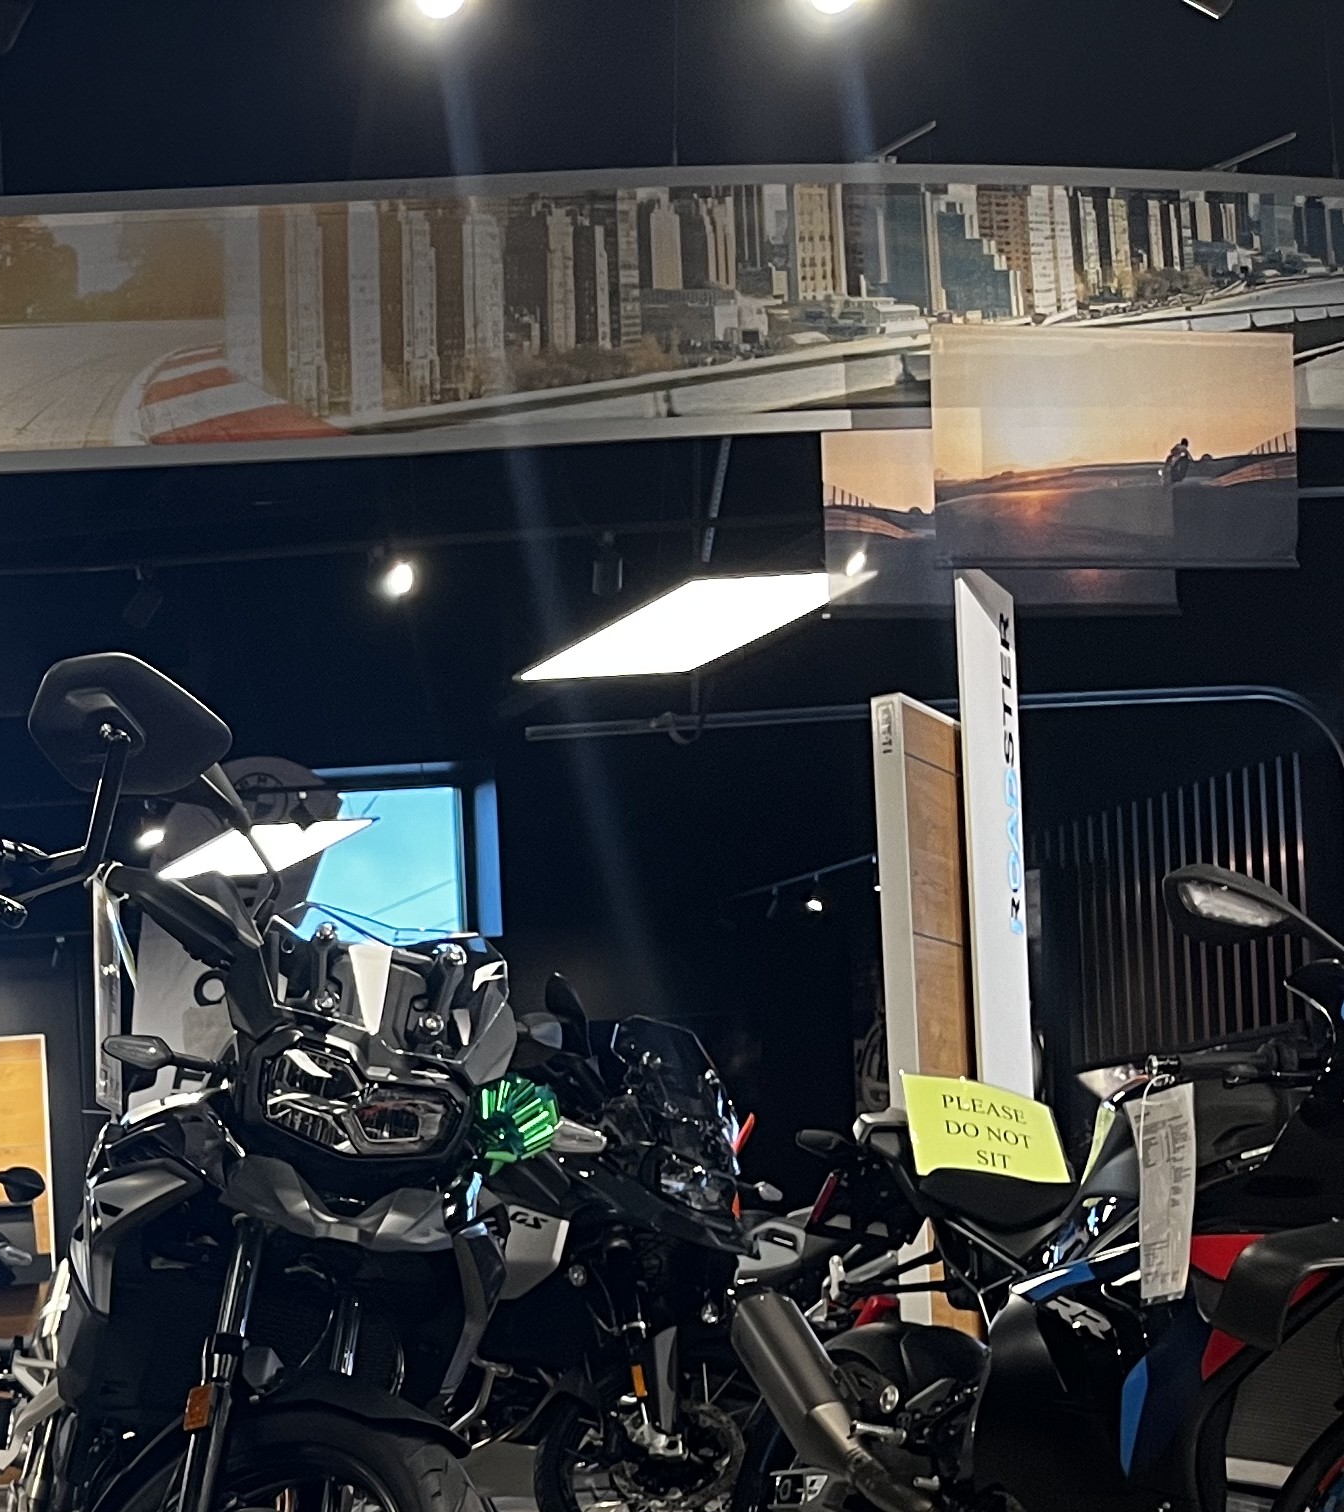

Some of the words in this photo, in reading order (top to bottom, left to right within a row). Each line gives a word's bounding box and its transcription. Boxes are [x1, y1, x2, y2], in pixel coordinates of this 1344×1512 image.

[998, 612, 1023, 934] ROADSTER
[941, 1094, 1027, 1125] PLEASE
[945, 1120, 979, 1138] DO
[987, 1126, 1031, 1149] NOT
[976, 1150, 1011, 1169] SIT
